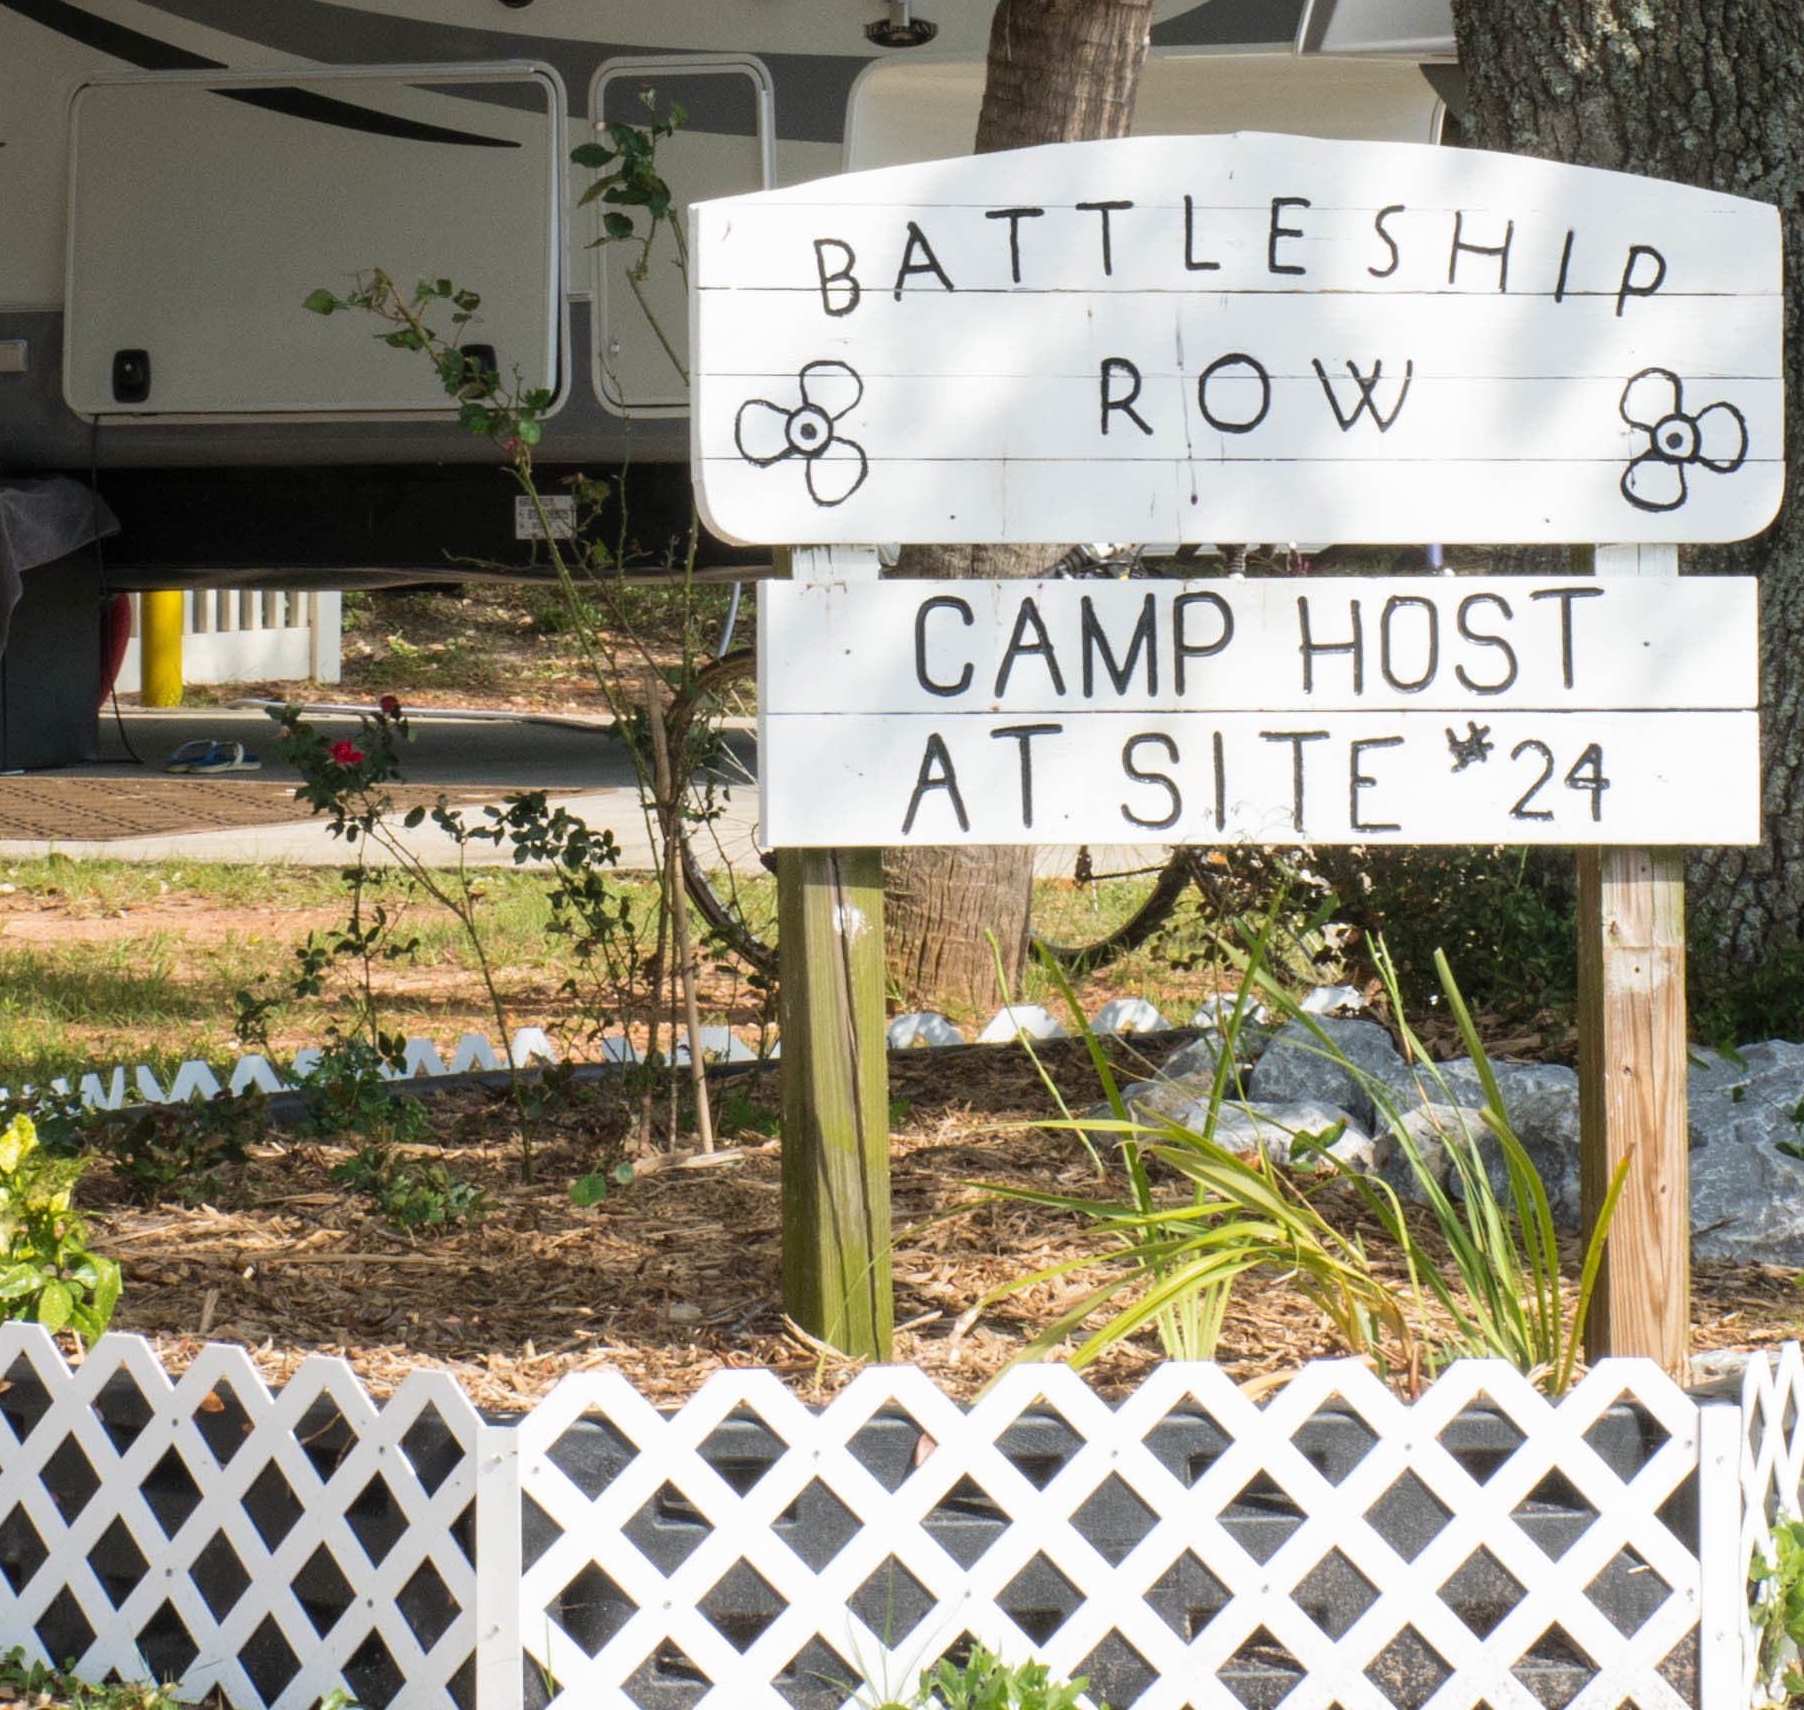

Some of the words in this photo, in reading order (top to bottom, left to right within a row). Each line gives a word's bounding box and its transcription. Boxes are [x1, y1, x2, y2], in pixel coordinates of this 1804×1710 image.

[812, 194, 1667, 318] BATTLESHIP
[1099, 352, 1414, 436] ROW
[914, 591, 1235, 698] CAMP
[1296, 586, 1605, 696] HOST
[901, 722, 1064, 835] AT
[1119, 729, 1407, 835] SITE
[1444, 720, 1611, 824] #24
